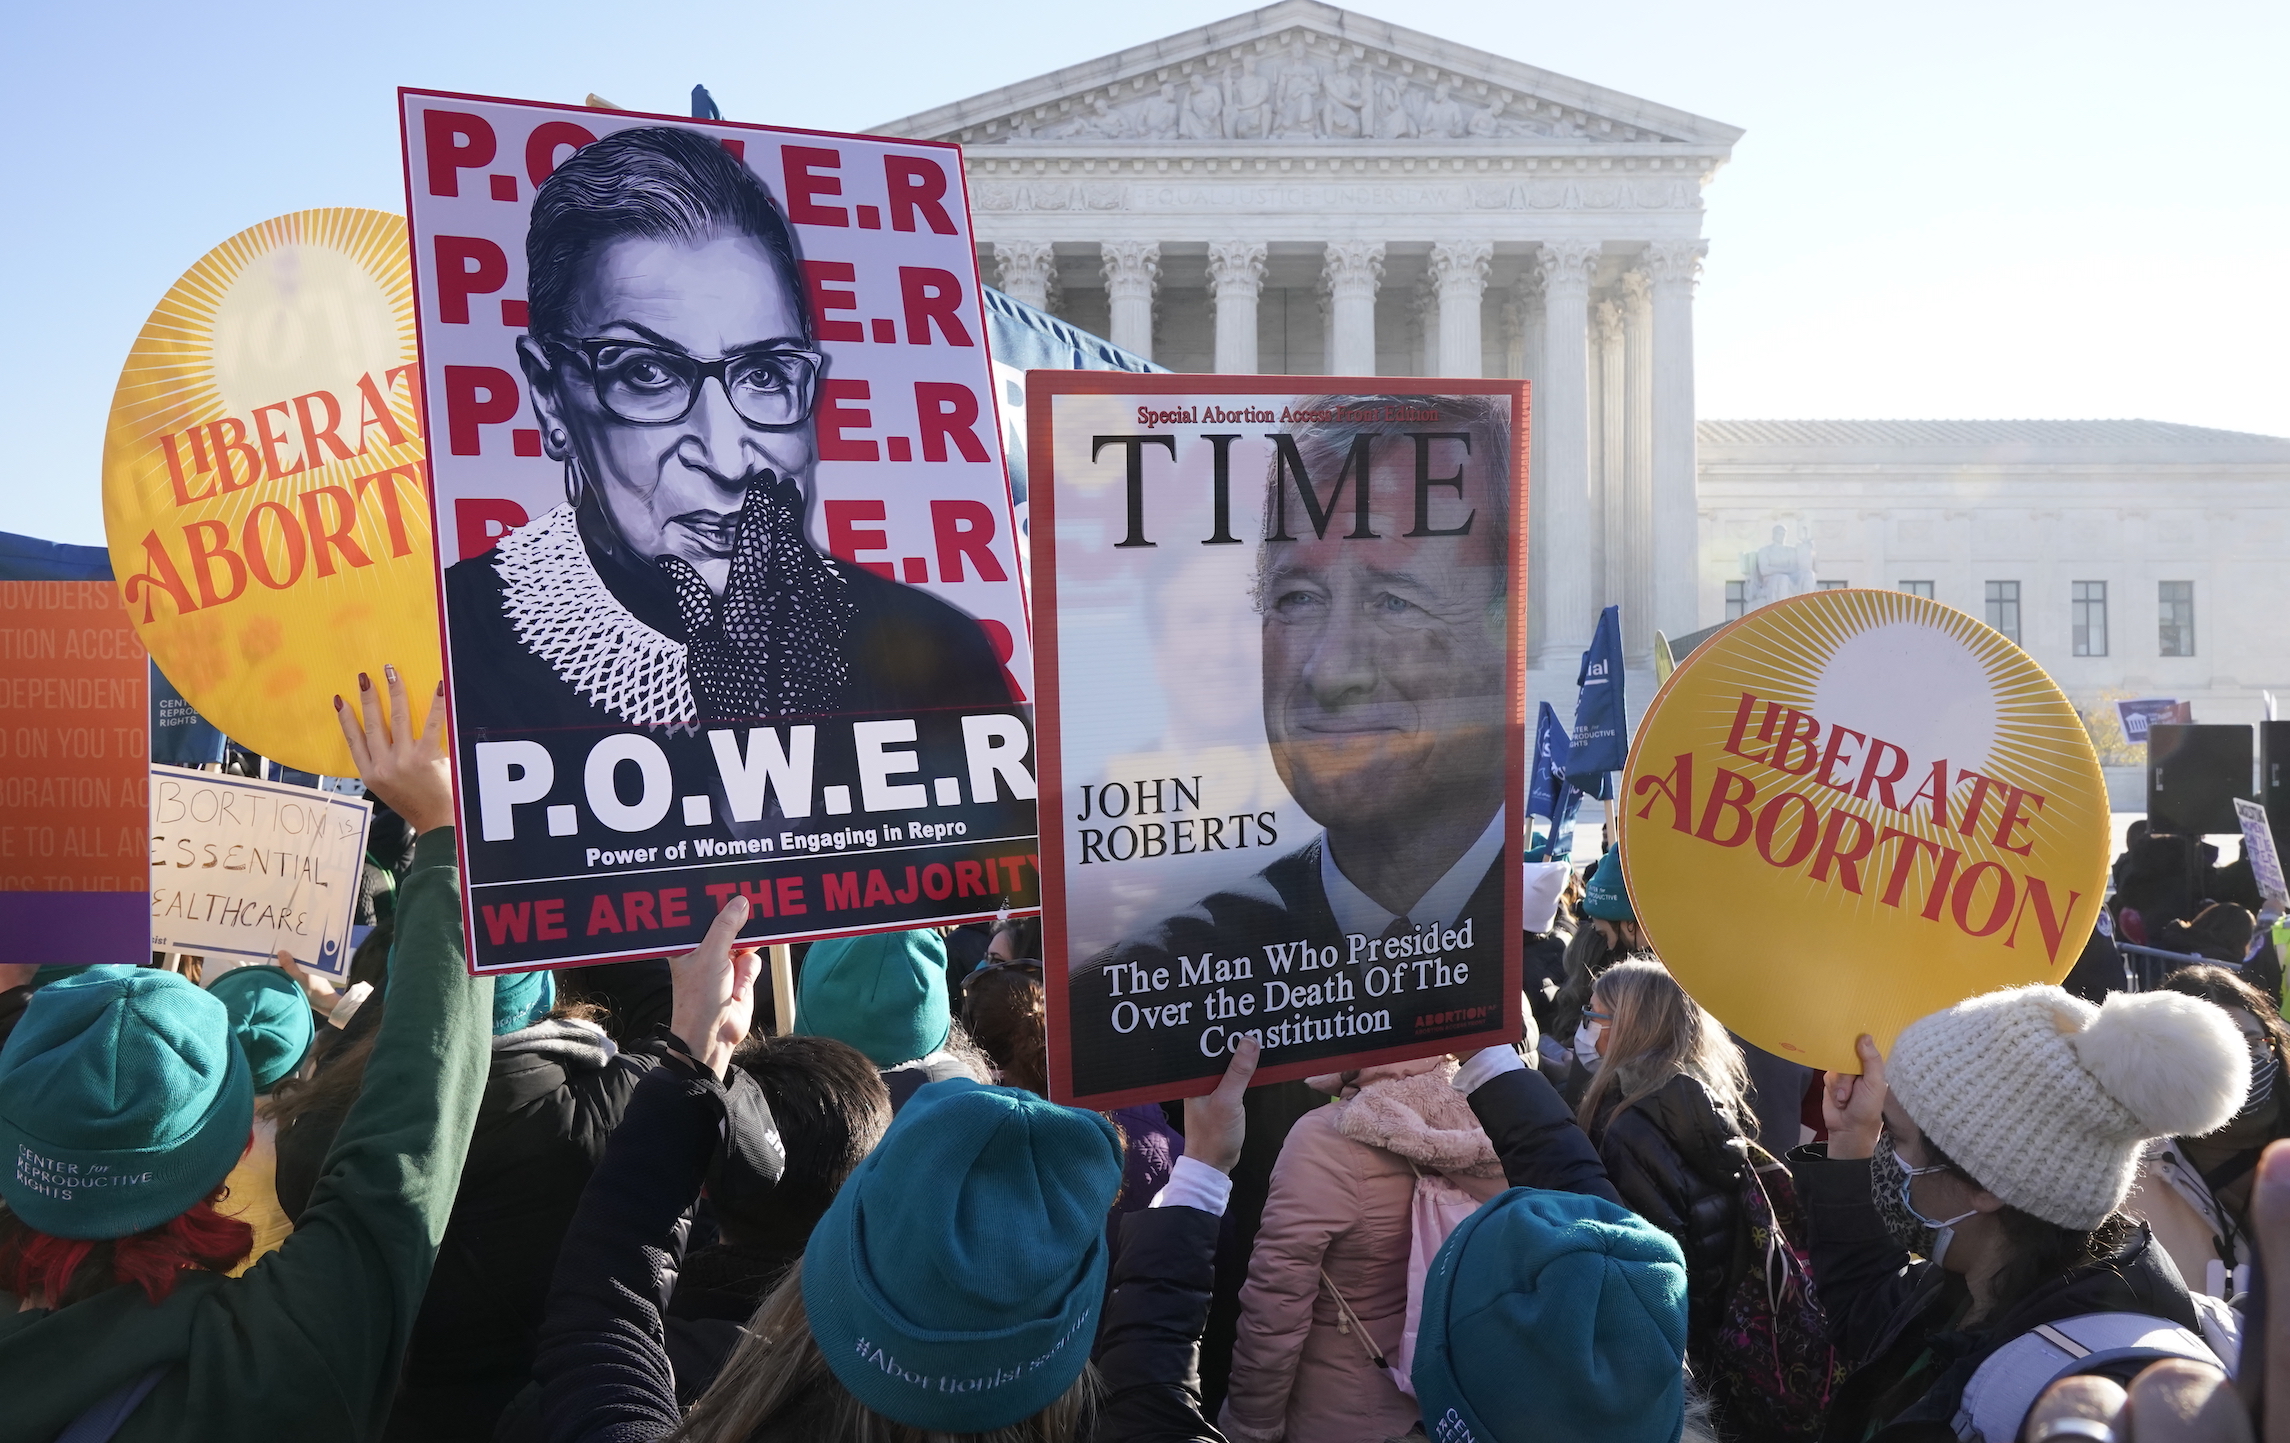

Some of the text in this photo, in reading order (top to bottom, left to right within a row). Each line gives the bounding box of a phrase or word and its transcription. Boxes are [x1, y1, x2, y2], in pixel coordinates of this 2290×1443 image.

[1145, 188, 1451, 205] EQUAL JUSTICE UNDER LAW
[1137, 406, 1439, 428] Special Abortion Access Front Edition
[1092, 431, 1476, 548] TIME
[160, 716, 197, 727] RIGHTS
[16, 727, 48, 758] ON
[57, 727, 105, 759] YOU
[113, 727, 144, 759] TO
[476, 713, 1037, 842] P.O.W.E.R
[1723, 691, 2046, 857] LIBERATE
[1077, 775, 1203, 821] JOHN
[24, 827, 54, 857] TO
[63, 827, 109, 857] ALL
[338, 817, 353, 835] is
[586, 820, 967, 867] Power of Women Engaging in Repro
[1078, 810, 1278, 865] ROBERTS
[1634, 751, 2081, 967] ABORTION
[482, 898, 568, 946] WE
[585, 886, 691, 936] ARE
[705, 876, 808, 919] THE
[1103, 918, 1475, 997] The Man Who Presided
[1111, 956, 1470, 1034] Over the Death Of The
[1199, 1006, 1393, 1058] Constitution
[1415, 1006, 1486, 1026] ABORTION
[1415, 1019, 1486, 1035] ABORTION ACCESS FRONT
[17, 1156, 153, 1188] REPRODUCTIVE
[18, 1143, 111, 1175] CENTER for
[16, 1169, 72, 1200] RIGHTS
